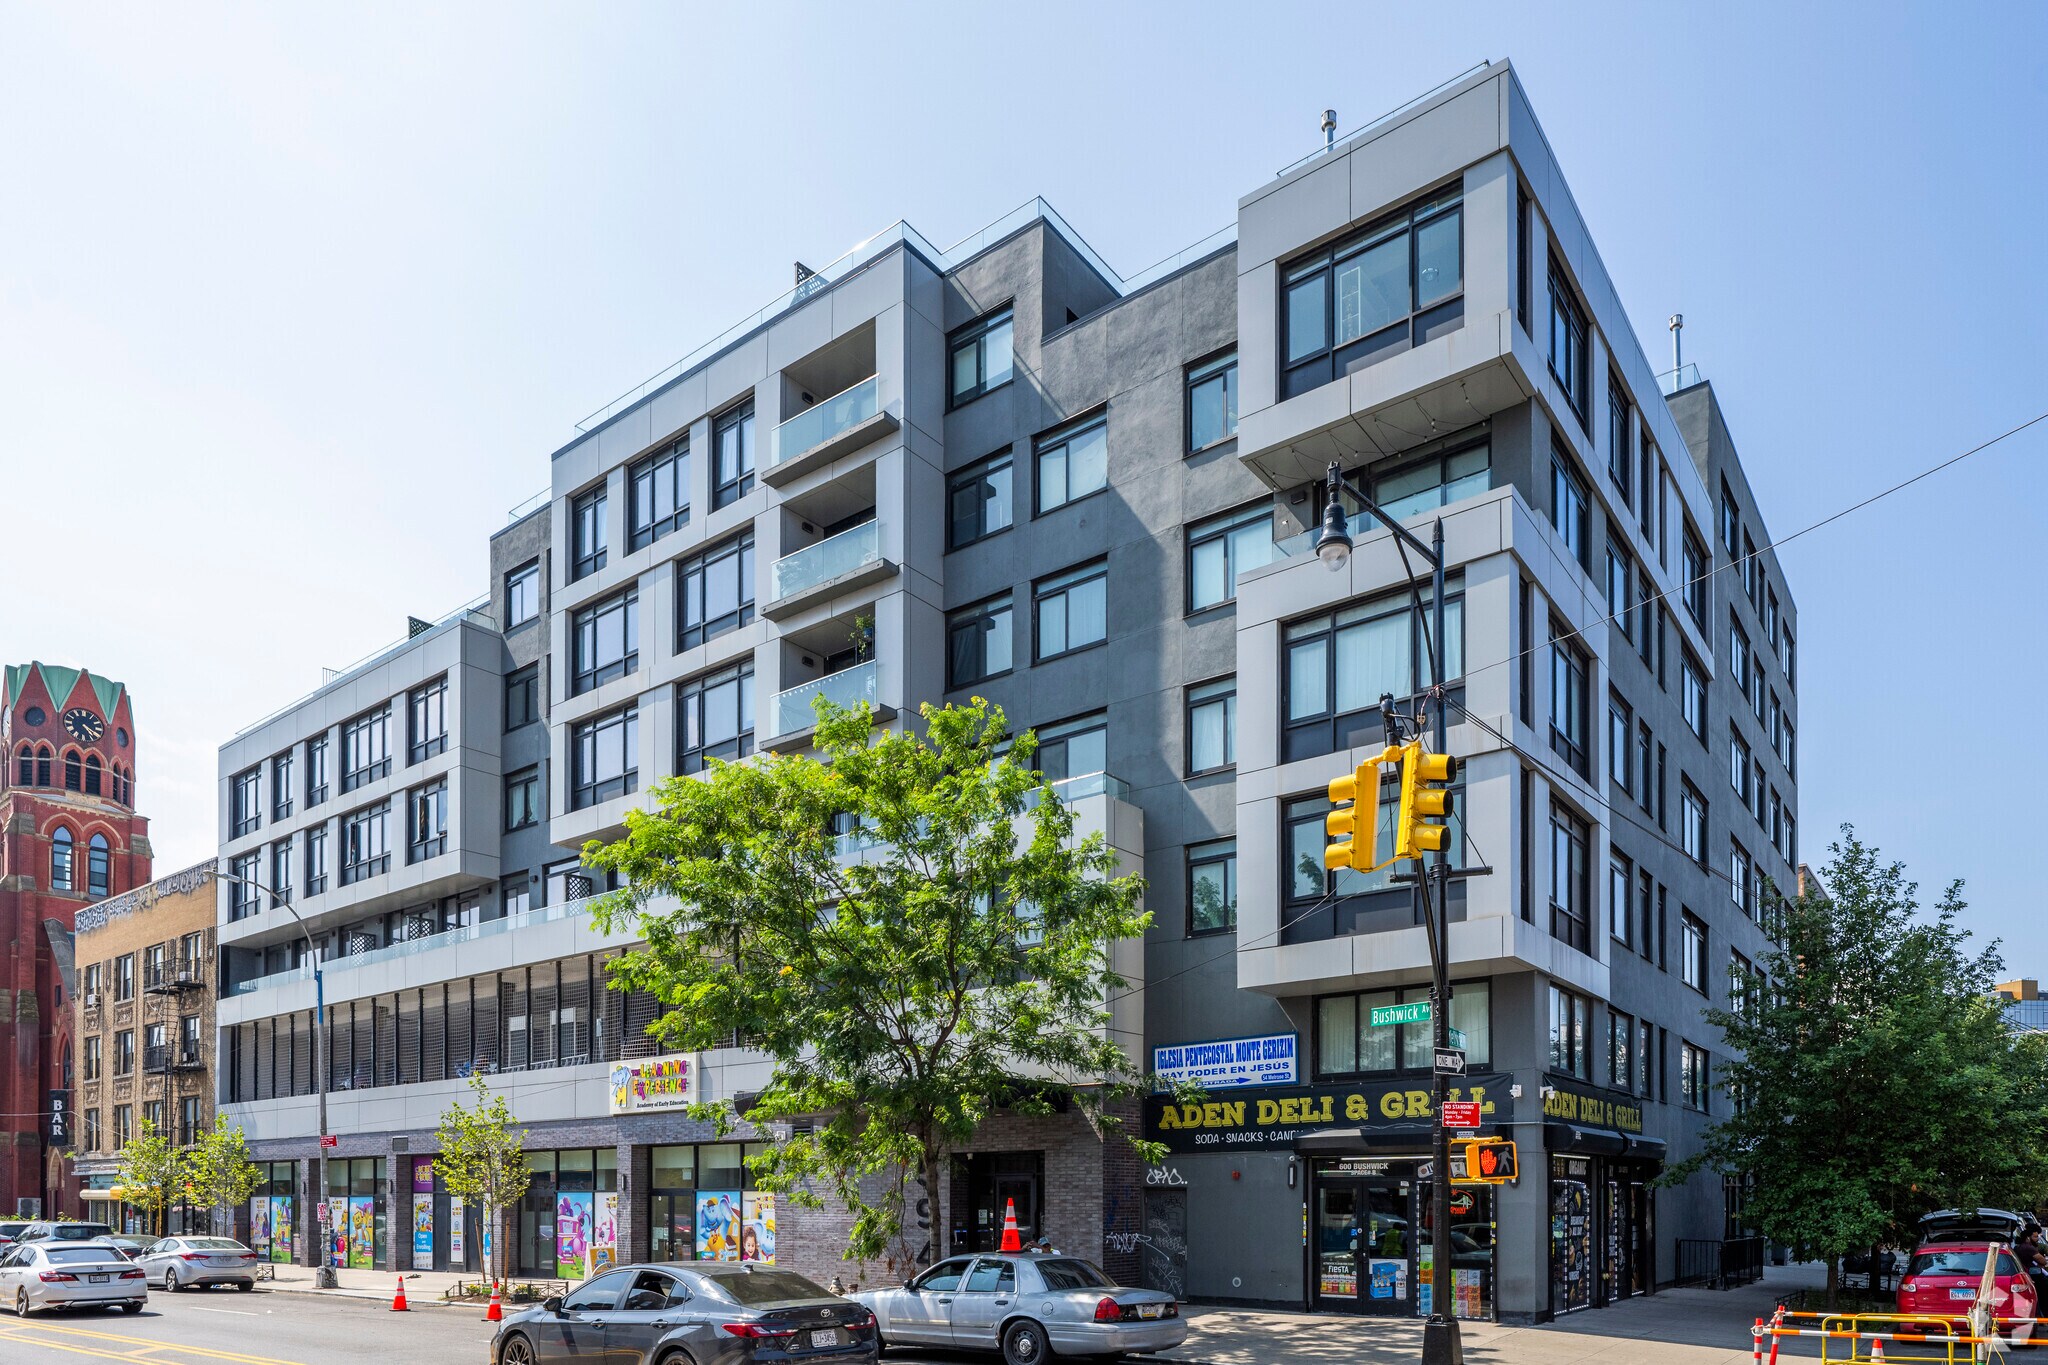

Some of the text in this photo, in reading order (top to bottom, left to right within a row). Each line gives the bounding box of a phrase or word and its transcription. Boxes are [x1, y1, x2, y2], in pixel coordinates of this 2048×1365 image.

[1373, 1004, 1418, 1024] Bushwick
[1157, 1037, 1293, 1070] IGLESIA PENTECOSTAL MONTE GERIZIM
[1438, 1056, 1461, 1067] ONE WAY
[640, 1059, 688, 1079] LEARNING
[1162, 1061, 1289, 1079] HAY PODER EN JESÚS
[632, 1077, 688, 1100] EXPERIENCE
[52, 1099, 64, 1136] BAR
[1158, 1087, 1496, 1129] ADEN DELI & GRL
[1544, 1090, 1642, 1132] ADEN DELI & GRILL
[1195, 1133, 1220, 1145] SODA
[1225, 1131, 1263, 1143] SNACKS
[1353, 1162, 1389, 1170] BUSHWICK
